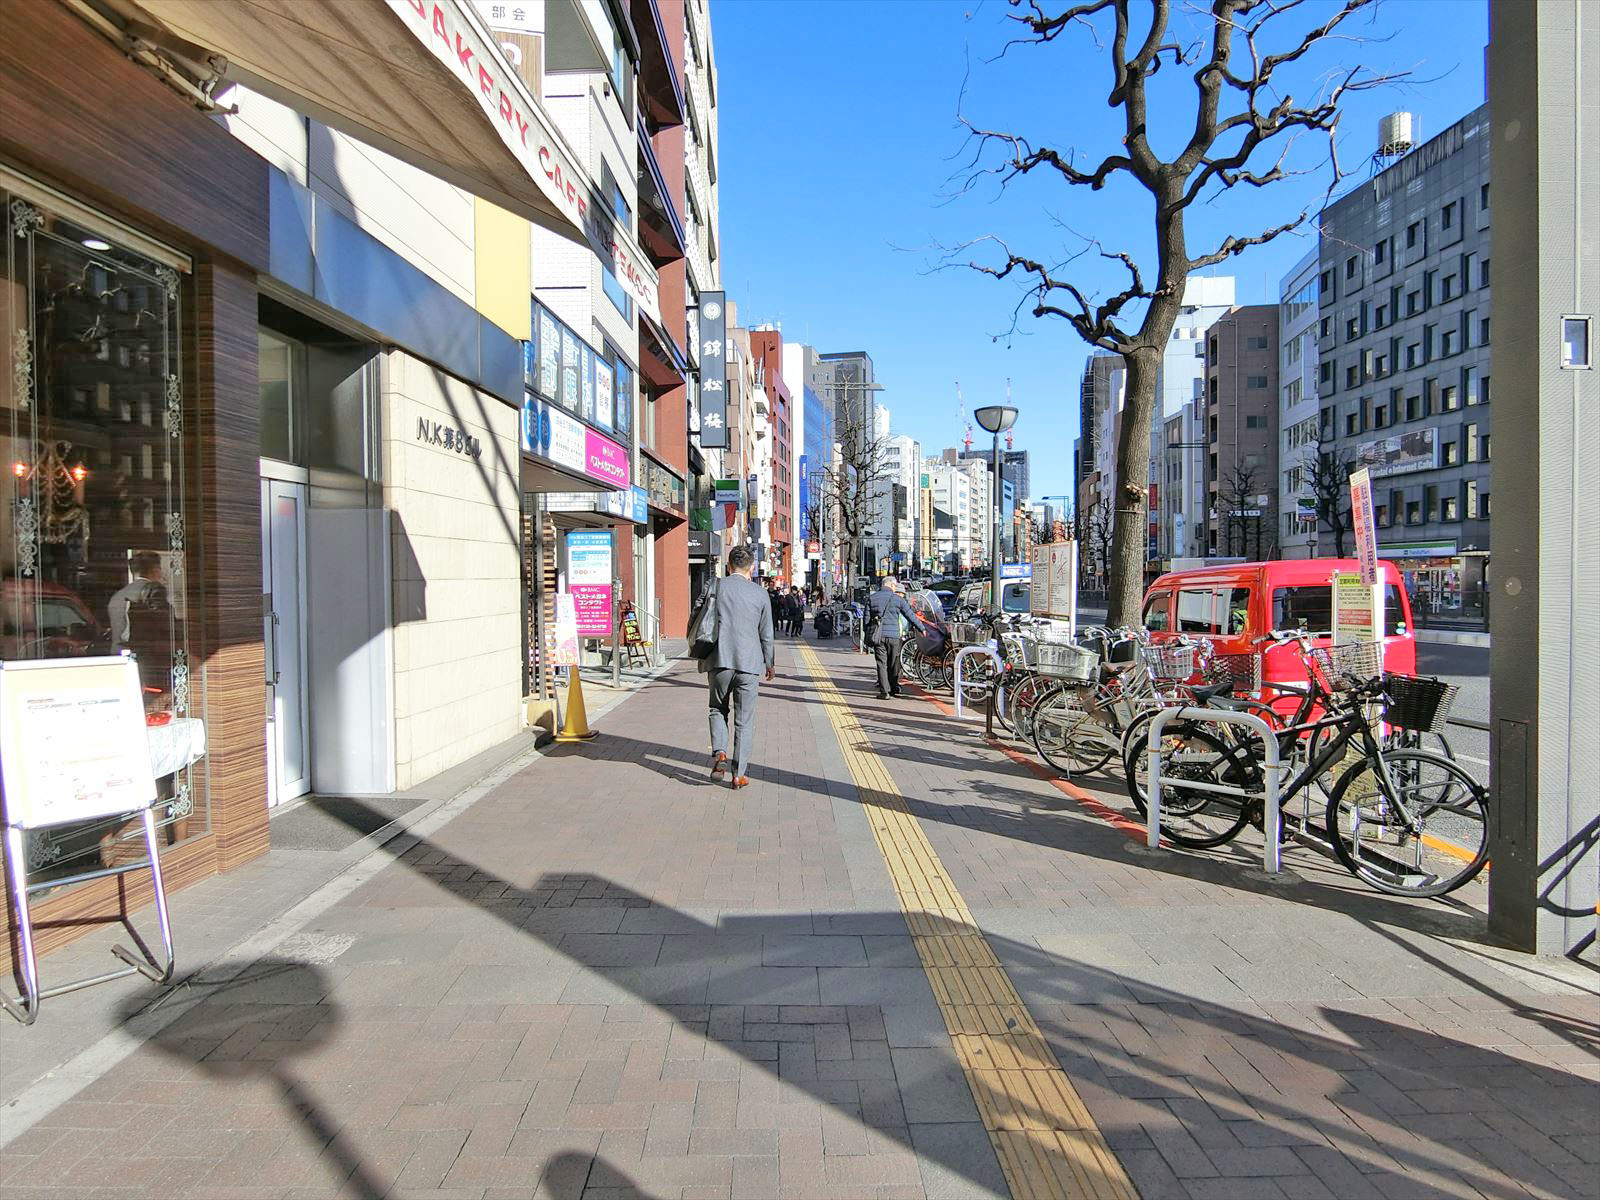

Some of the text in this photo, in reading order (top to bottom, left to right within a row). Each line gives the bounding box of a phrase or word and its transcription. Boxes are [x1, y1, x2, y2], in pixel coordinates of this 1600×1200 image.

[539, 146, 588, 222] CAFE
[702, 339, 724, 430] 錦松梅
